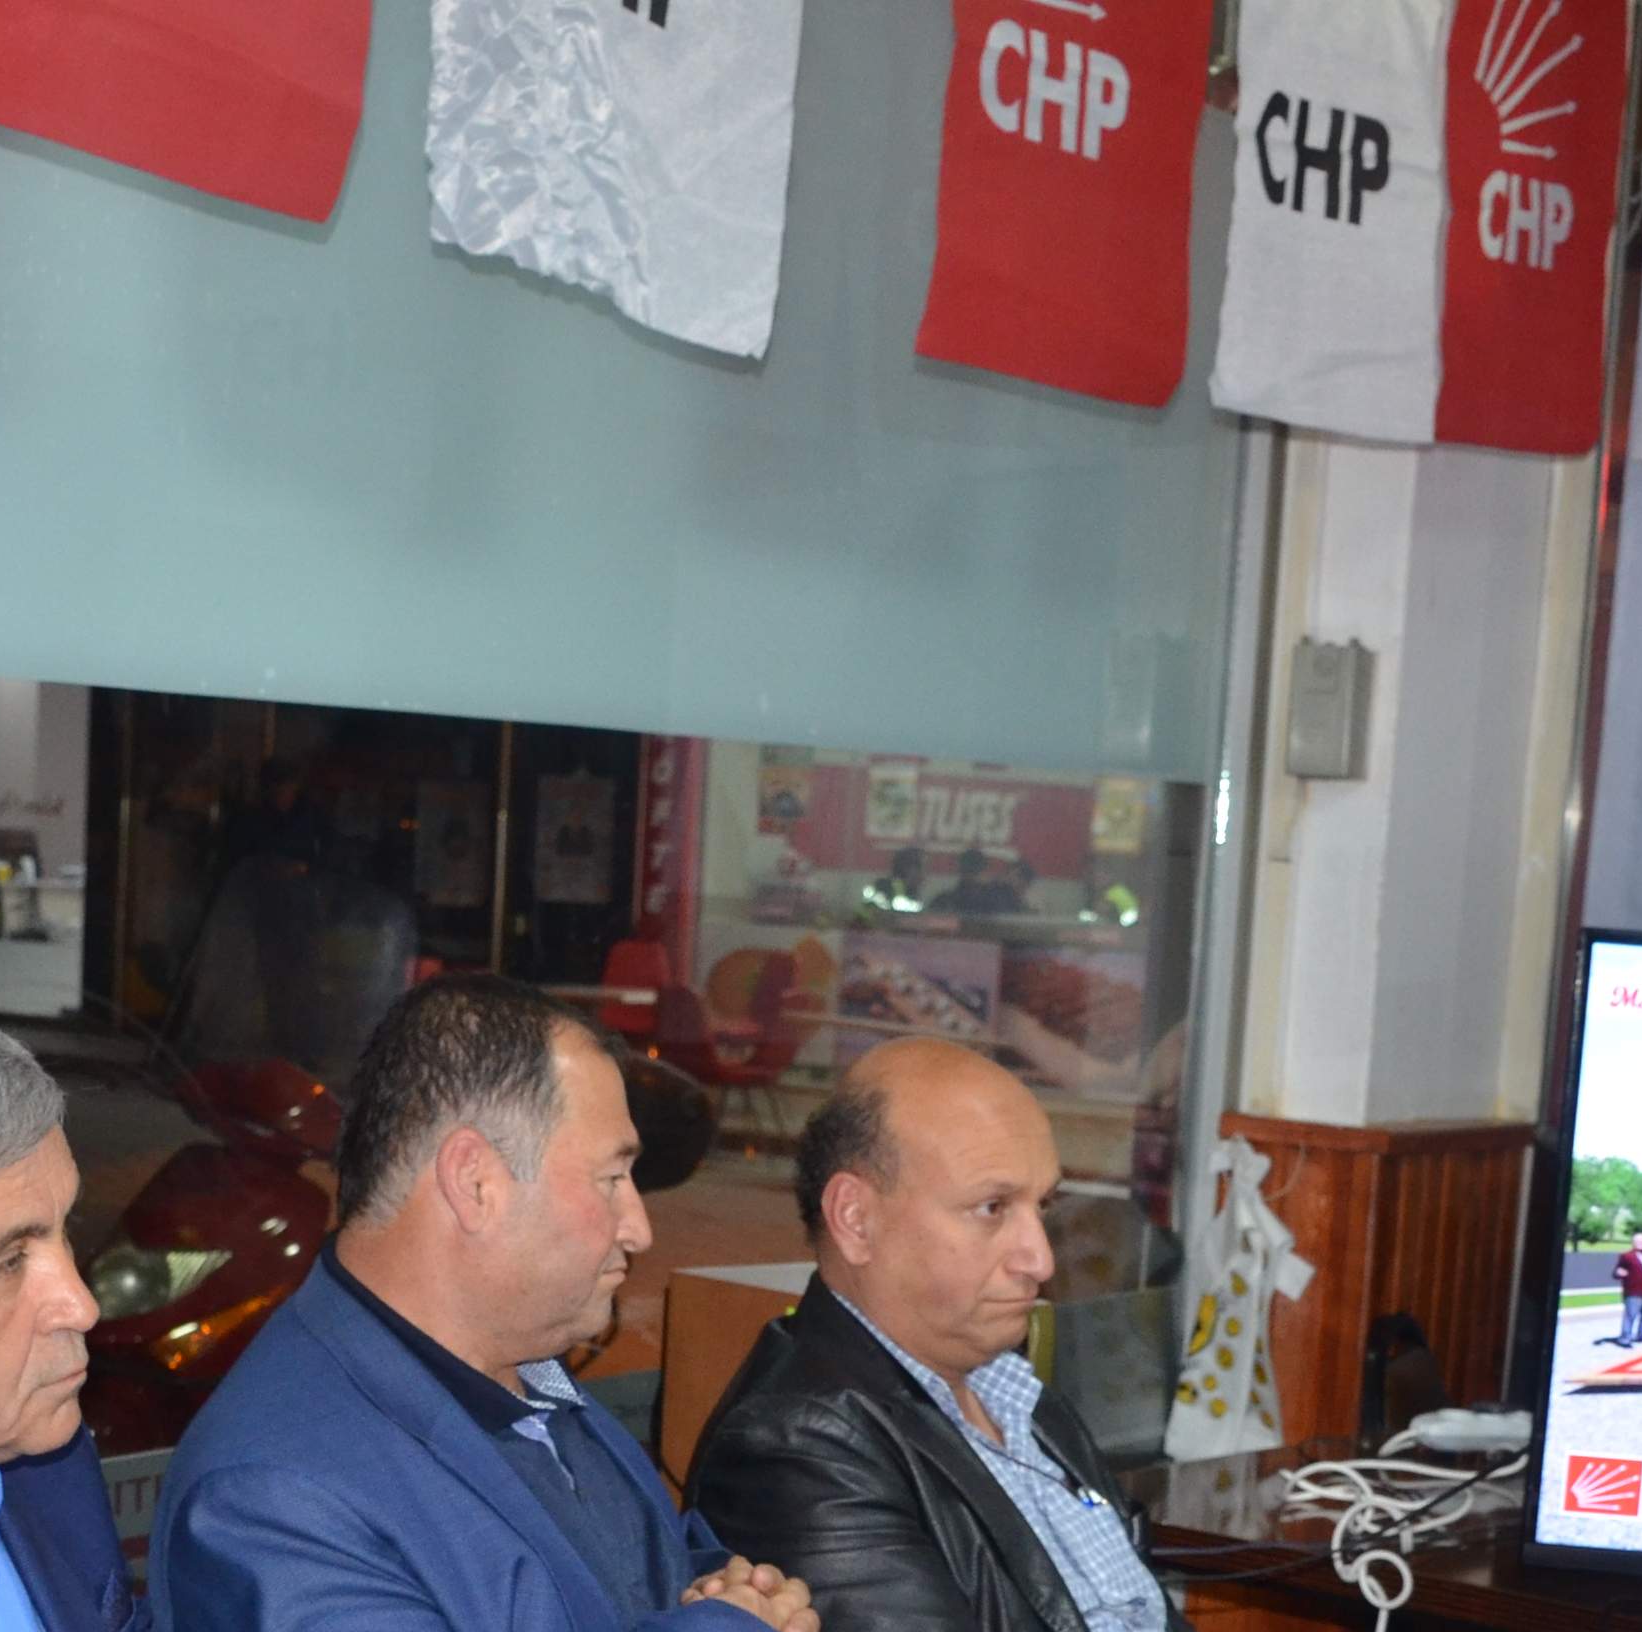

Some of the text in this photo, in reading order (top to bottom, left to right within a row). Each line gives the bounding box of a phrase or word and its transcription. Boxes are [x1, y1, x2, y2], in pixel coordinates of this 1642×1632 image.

[979, 18, 1131, 161] CHP
[1256, 91, 1390, 225] CHP
[1478, 169, 1574, 270] CHP
